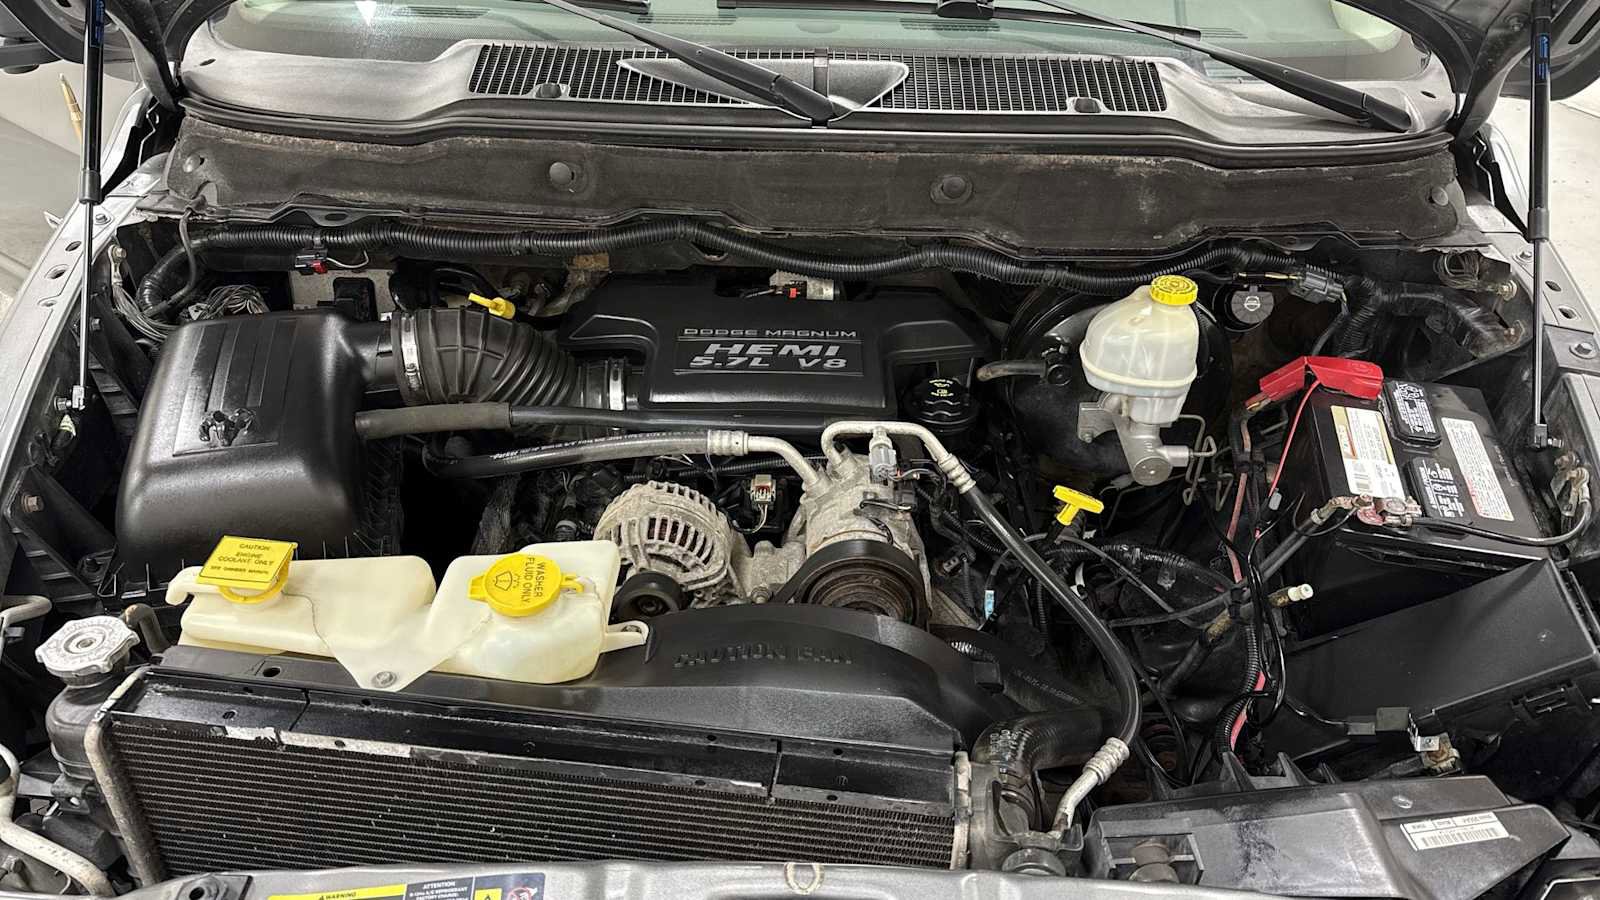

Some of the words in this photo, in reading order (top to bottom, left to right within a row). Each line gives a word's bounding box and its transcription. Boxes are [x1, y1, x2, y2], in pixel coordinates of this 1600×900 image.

[683, 328, 758, 336] DODGE
[765, 329, 857, 338] MAGNUM
[703, 343, 841, 357] HEMI
[689, 356, 770, 369] 5.7L
[798, 357, 848, 369] V8
[239, 543, 271, 551] CAUTION
[218, 555, 251, 564] COOLANT
[235, 551, 264, 559] ENGINE
[524, 557, 535, 581] FLUID
[533, 561, 545, 598] WASHER
[521, 582, 532, 603] ONLY
[422, 880, 456, 890] ATTENTION
[325, 891, 357, 900] WARNING
